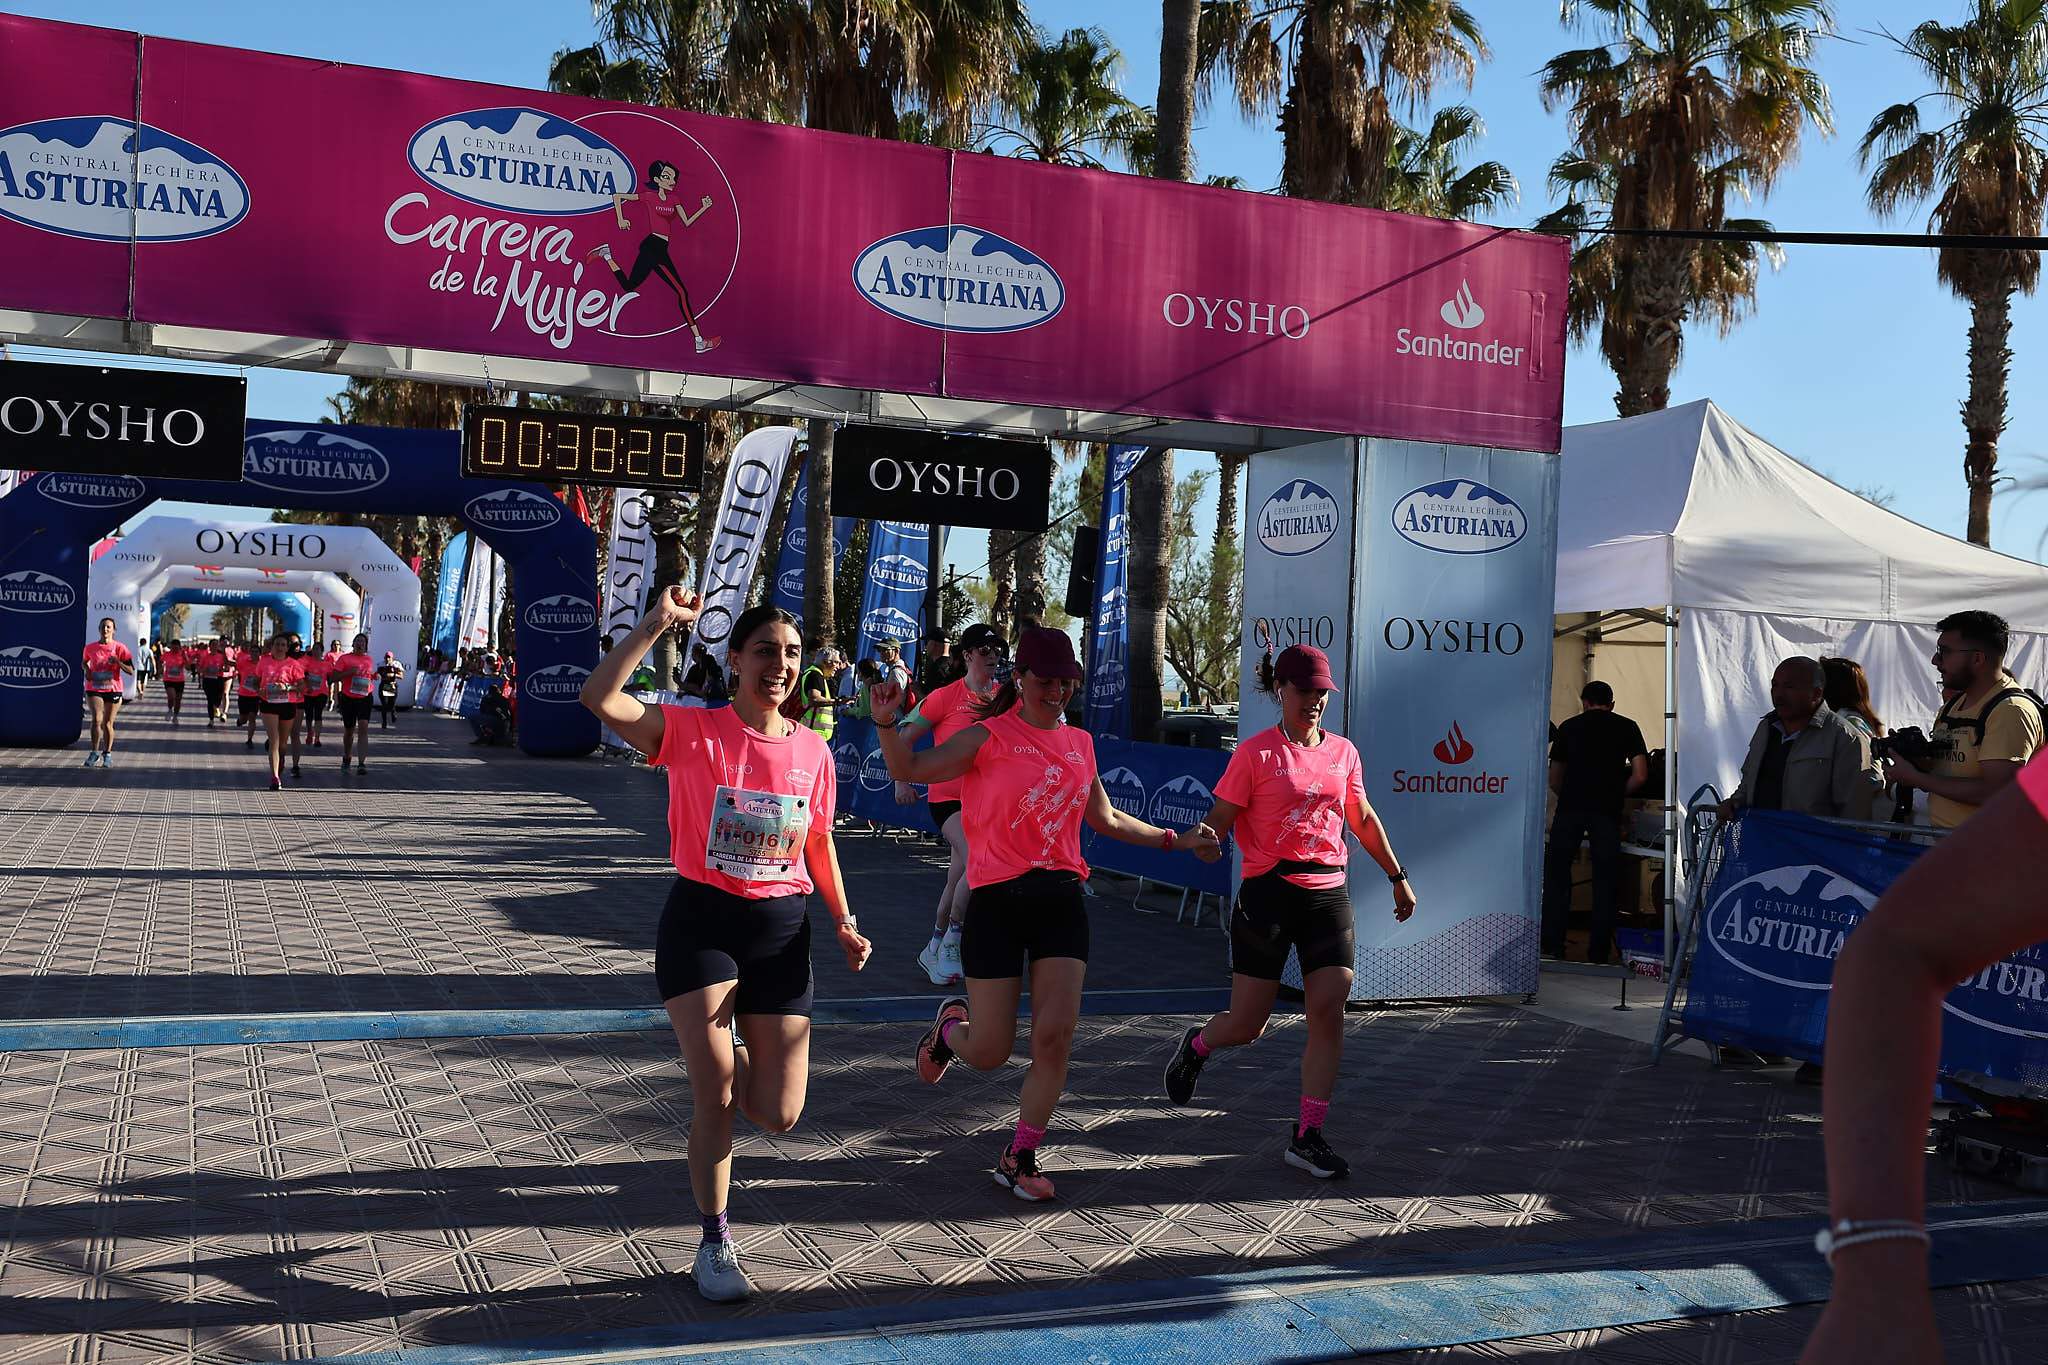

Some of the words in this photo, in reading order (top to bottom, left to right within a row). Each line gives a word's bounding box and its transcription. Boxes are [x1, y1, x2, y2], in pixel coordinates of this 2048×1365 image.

[29, 151, 120, 172] CENTRAL
[463, 136, 535, 156] CENTRAL
[542, 147, 613, 166] LECHERA
[425, 135, 620, 196] ASTURIANA
[384, 192, 573, 265] Carrera
[428, 254, 464, 293] de
[472, 257, 498, 298] la
[904, 256, 970, 273] CENTRAL
[976, 264, 1043, 281] LECHERA
[869, 255, 1049, 312] ASTURIANA
[490, 259, 641, 350] Mujer
[1163, 292, 1311, 340] OYSHO
[1396, 327, 1524, 369] Santander
[0, 396, 205, 447] OYSHO
[43, 476, 137, 498] ASTURIANA
[869, 457, 1020, 501] OYSHO
[472, 504, 555, 522] ASTURIANA
[1401, 503, 1517, 538] ASTURIANA
[1423, 503, 1466, 513] CENTRAL
[1470, 506, 1513, 517] LECHERA
[1261, 511, 1332, 539] ASTURIANA
[115, 552, 156, 562] OYSHO
[195, 528, 327, 559] OYSHO
[699, 459, 773, 644] OYSHO
[361, 563, 400, 573] OYSHO
[873, 563, 927, 588] ASTURIANA
[94, 601, 133, 612] OYSHO
[379, 613, 415, 624] OYSHO
[529, 607, 593, 624] ASTURIANA
[864, 618, 916, 640] ASTURIANA
[1253, 615, 1334, 649] OYSHO
[1384, 617, 1524, 656] OYSHO
[1392, 769, 1509, 795] Santander
[746, 803, 783, 816] ASTURIANA
[1754, 898, 1816, 919] CENTRAL
